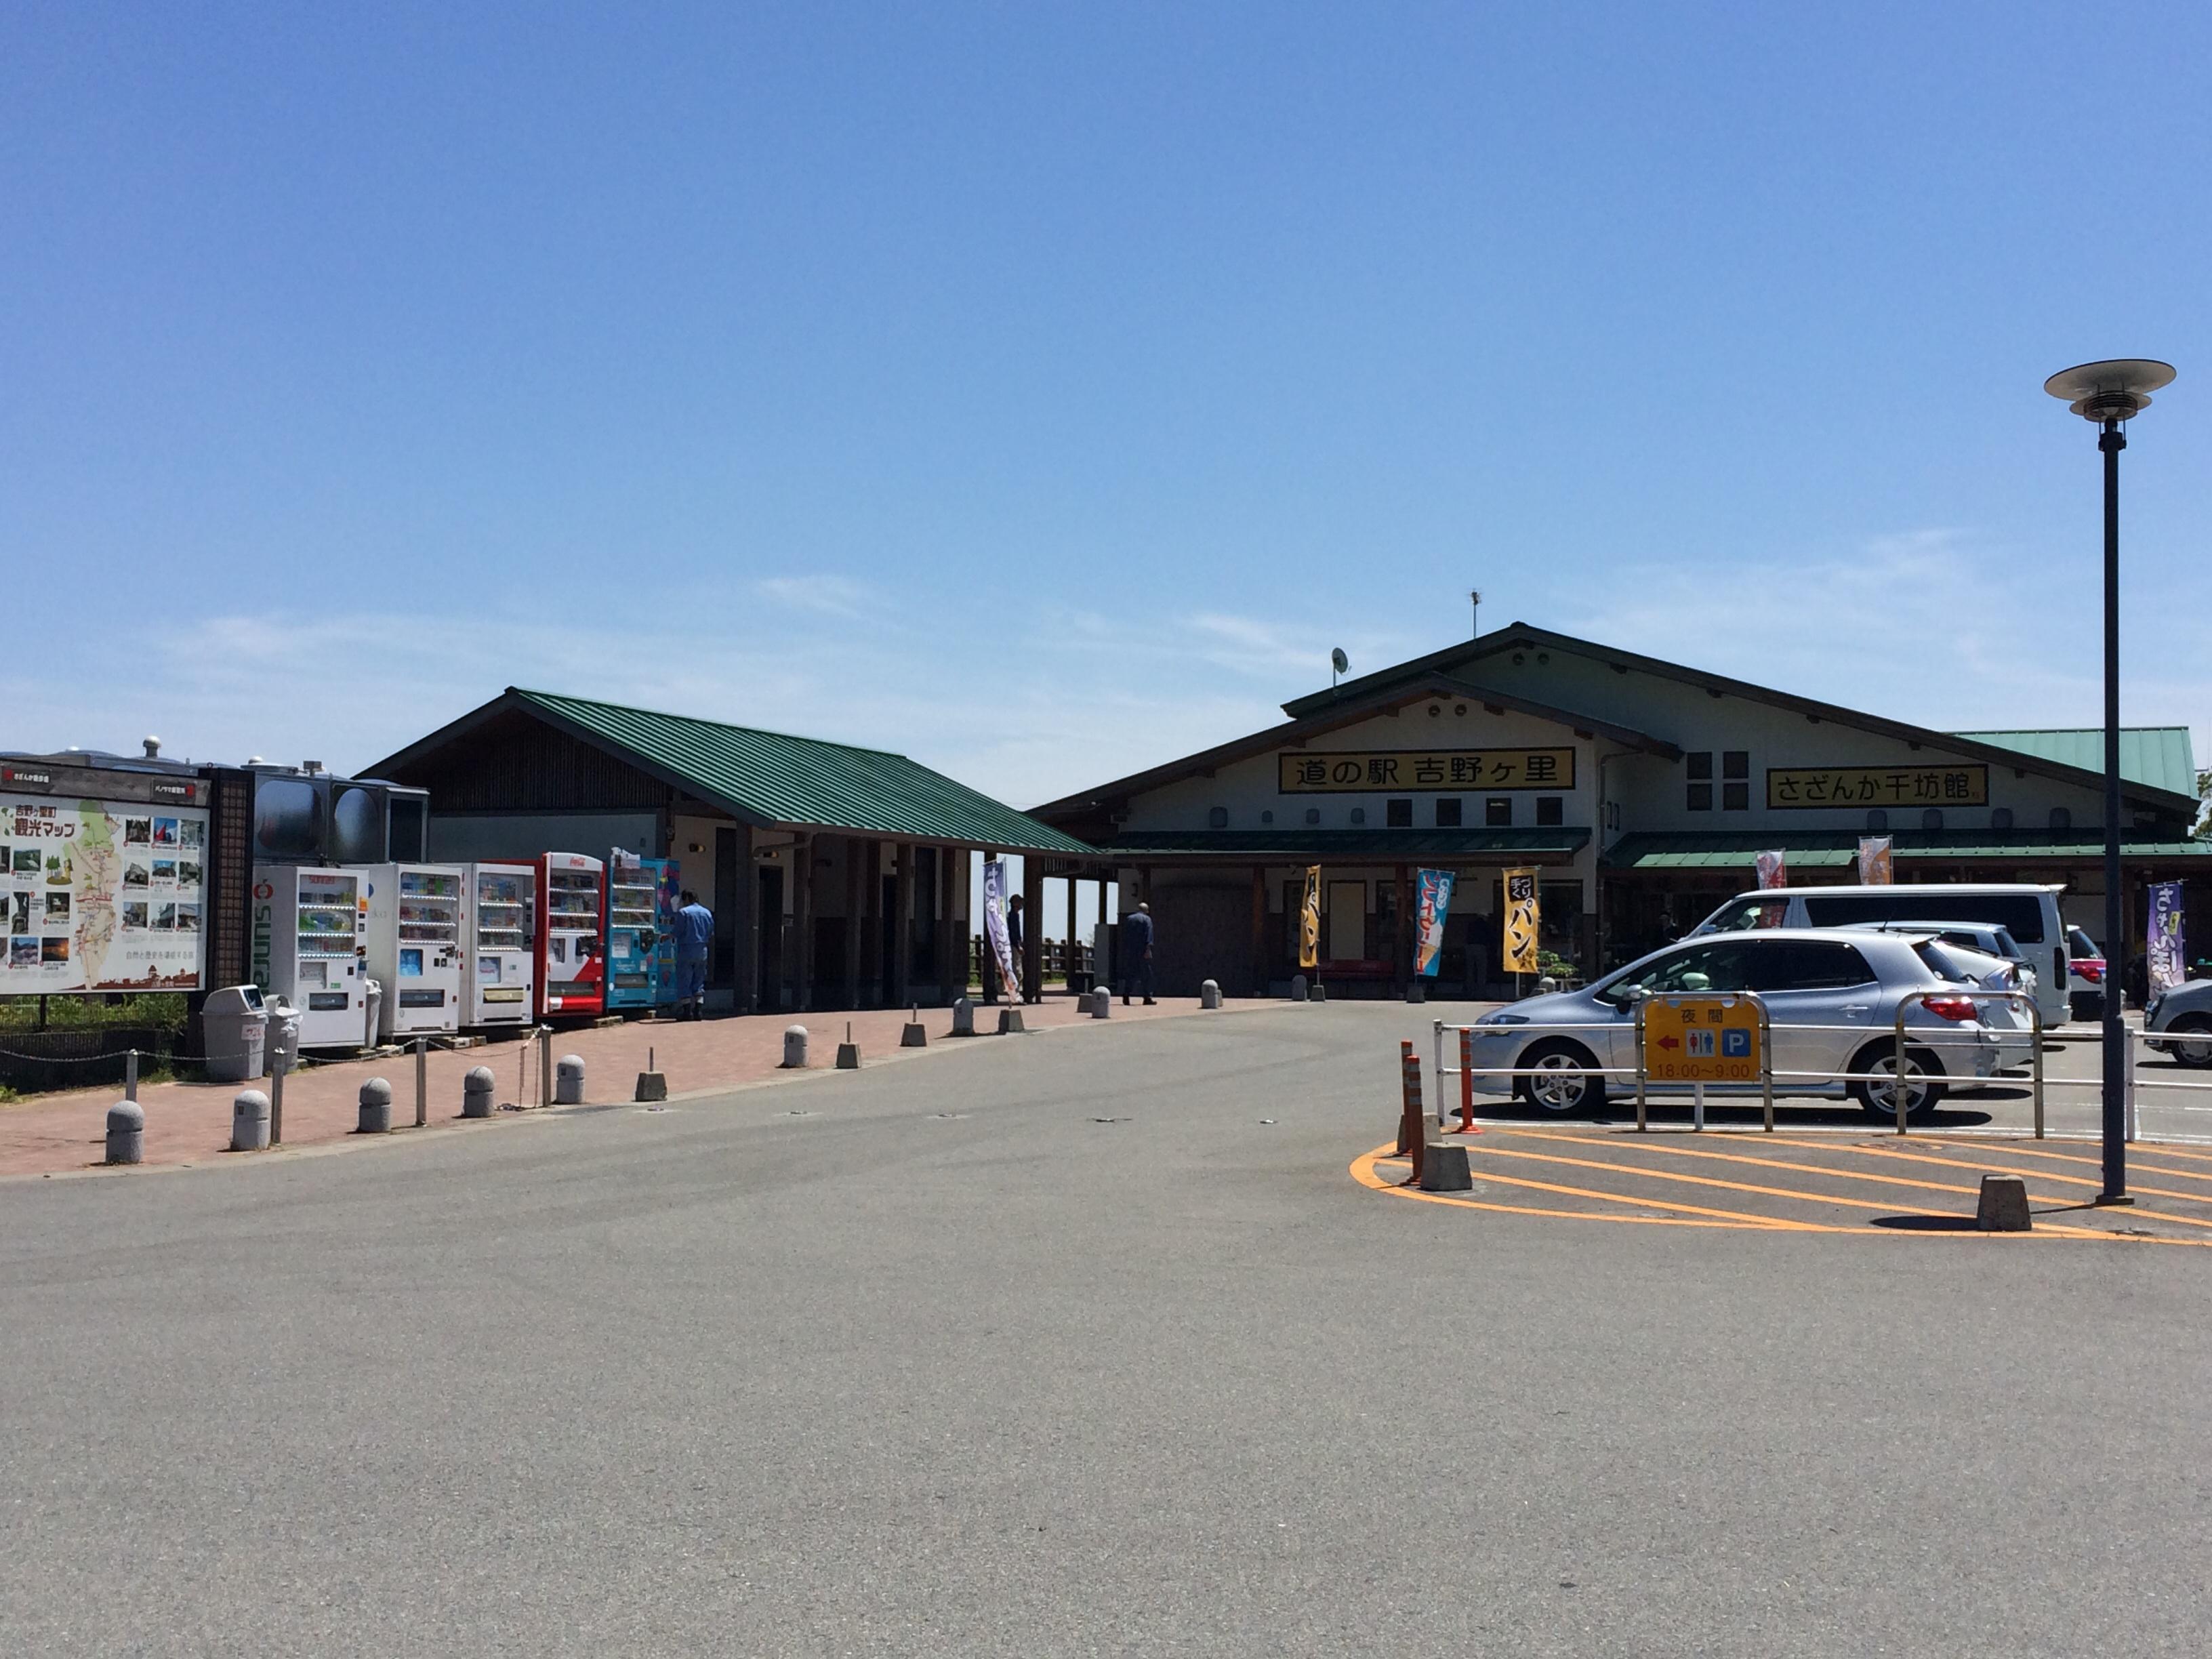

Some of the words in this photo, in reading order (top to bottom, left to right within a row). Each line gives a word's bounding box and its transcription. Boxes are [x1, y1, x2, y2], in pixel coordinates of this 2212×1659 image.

[1296, 757, 1399, 785] 道の駅
[1414, 756, 1557, 783] 吉野ヶ里
[1777, 772, 1970, 800] さざんか千坊館
[15, 818, 75, 838] 観光マップ
[1509, 899, 1534, 959] パン
[253, 905, 272, 996] sunra
[1681, 1008, 1724, 1024] 夜間
[1729, 1033, 1744, 1053] P
